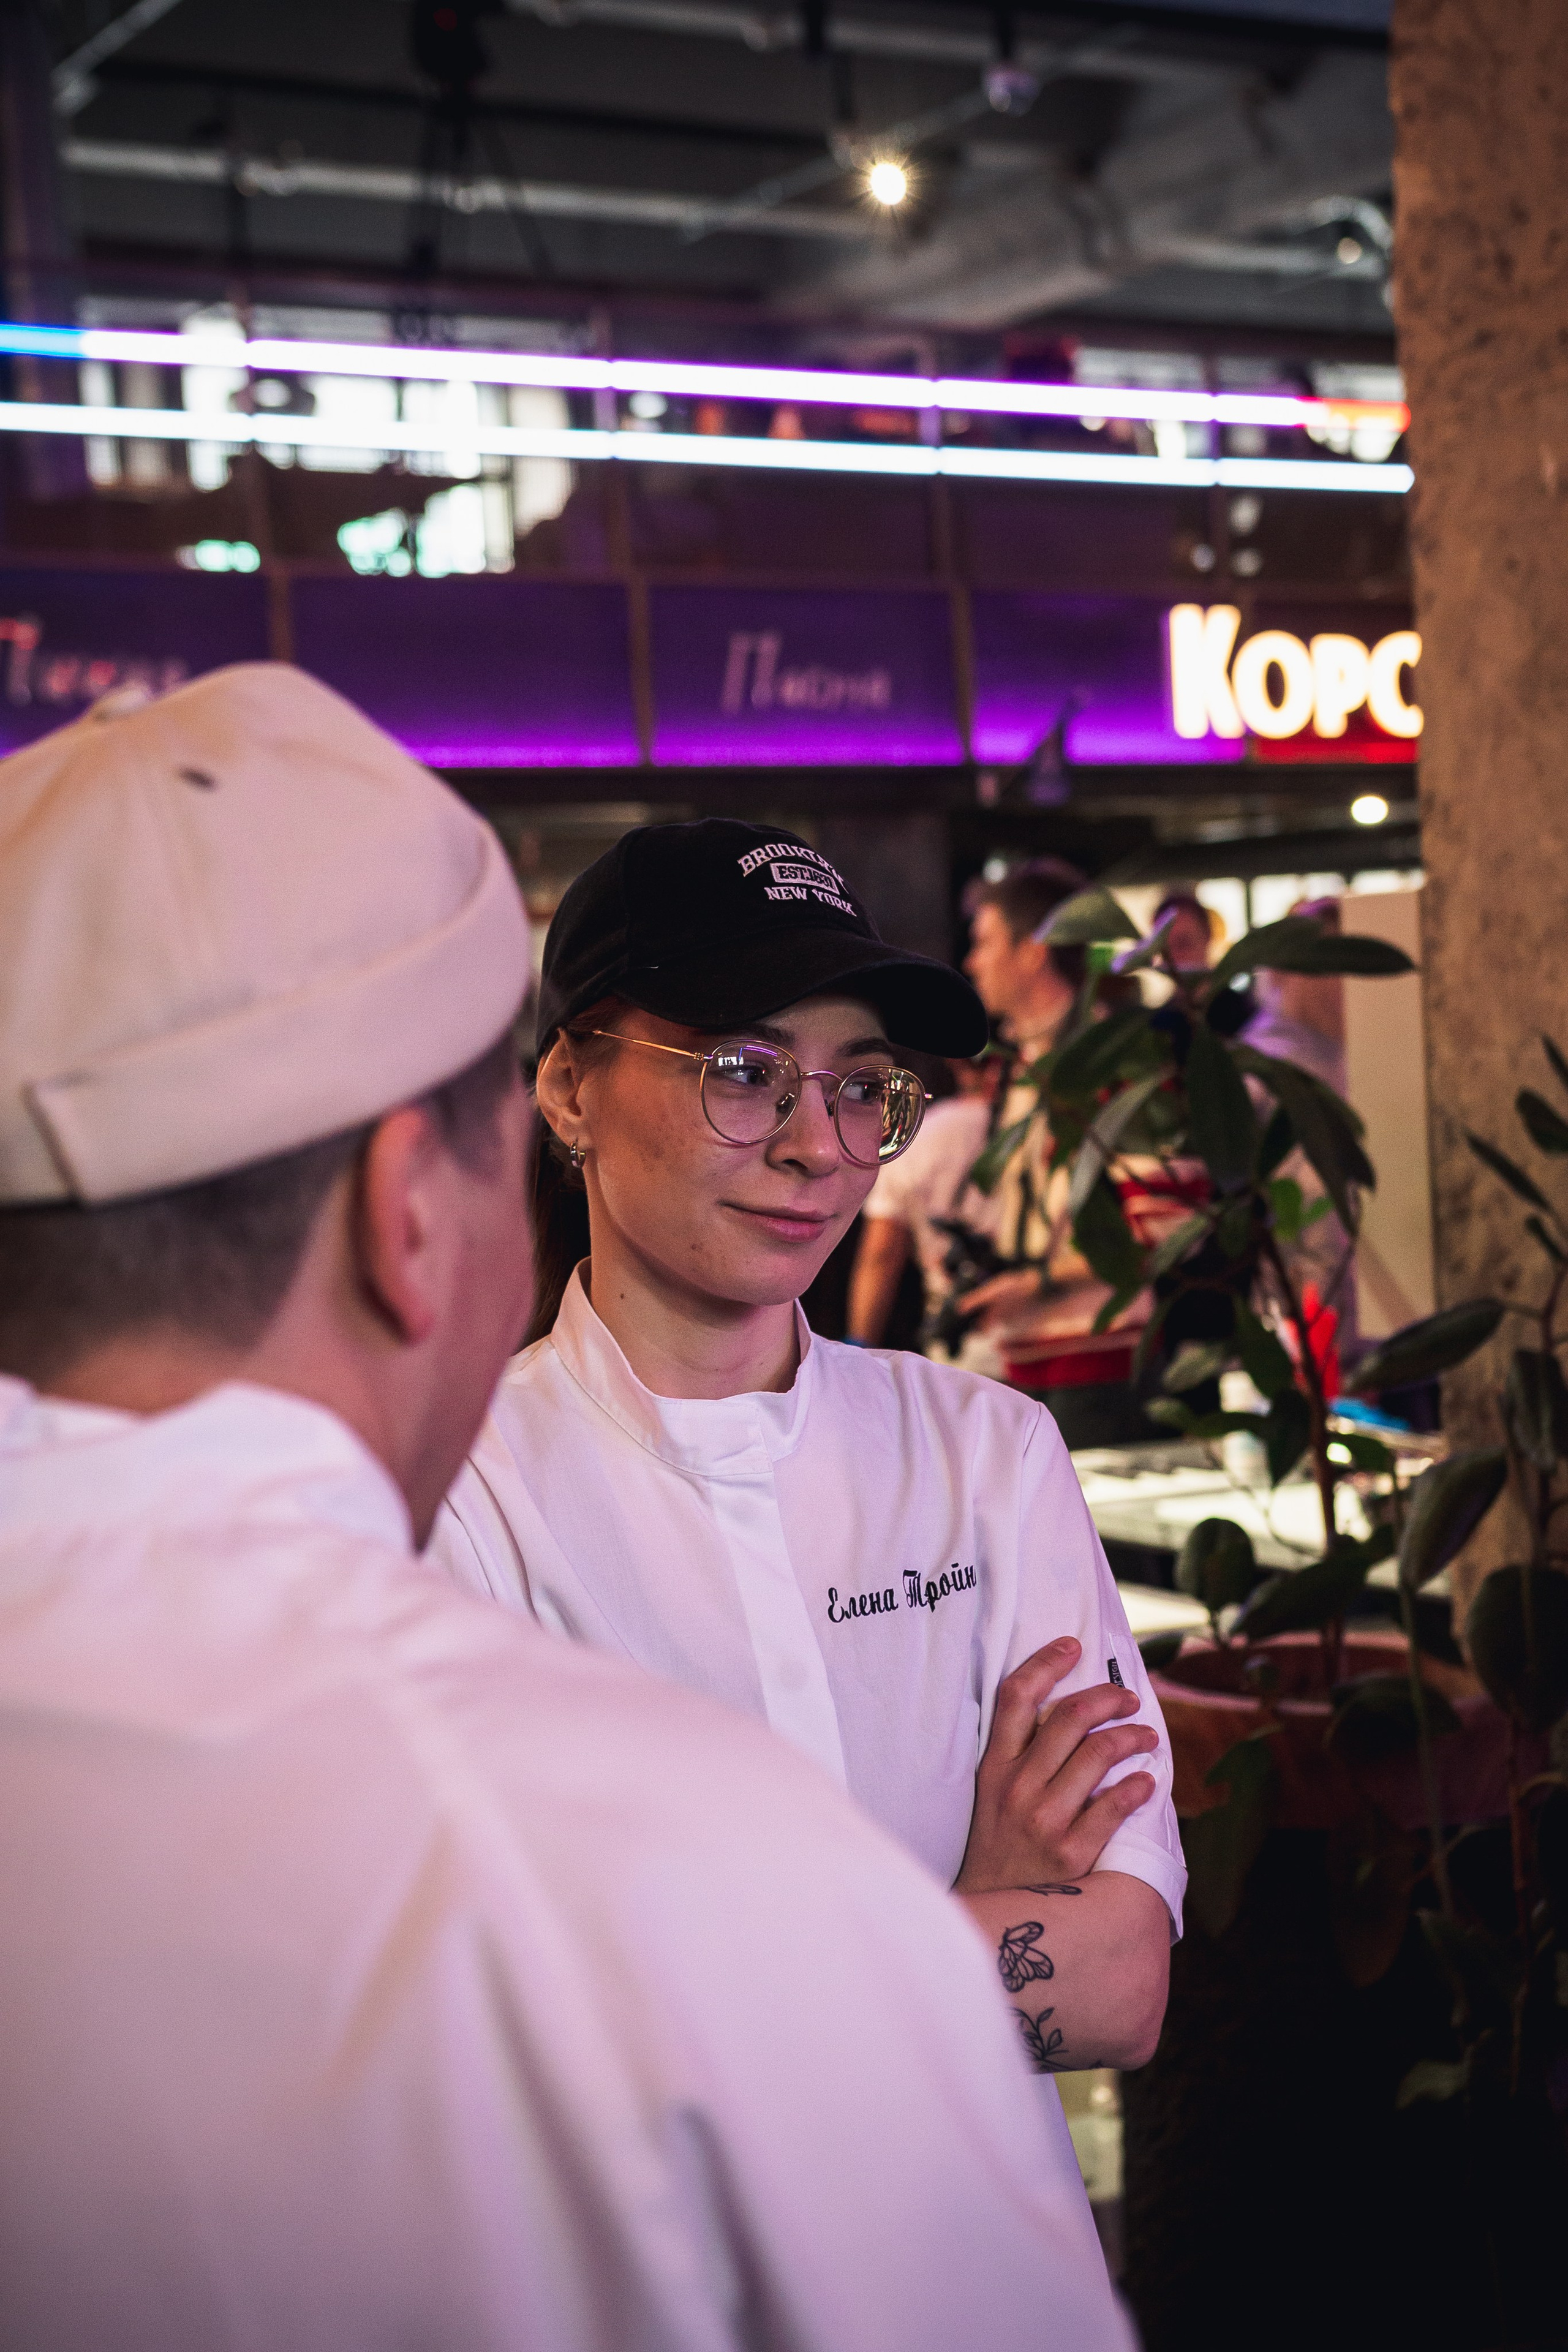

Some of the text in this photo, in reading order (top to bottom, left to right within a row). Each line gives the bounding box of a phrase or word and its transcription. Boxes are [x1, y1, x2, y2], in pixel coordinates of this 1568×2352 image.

[764, 886, 857, 918] NEW YORK
[827, 1587, 899, 1623] Елена
